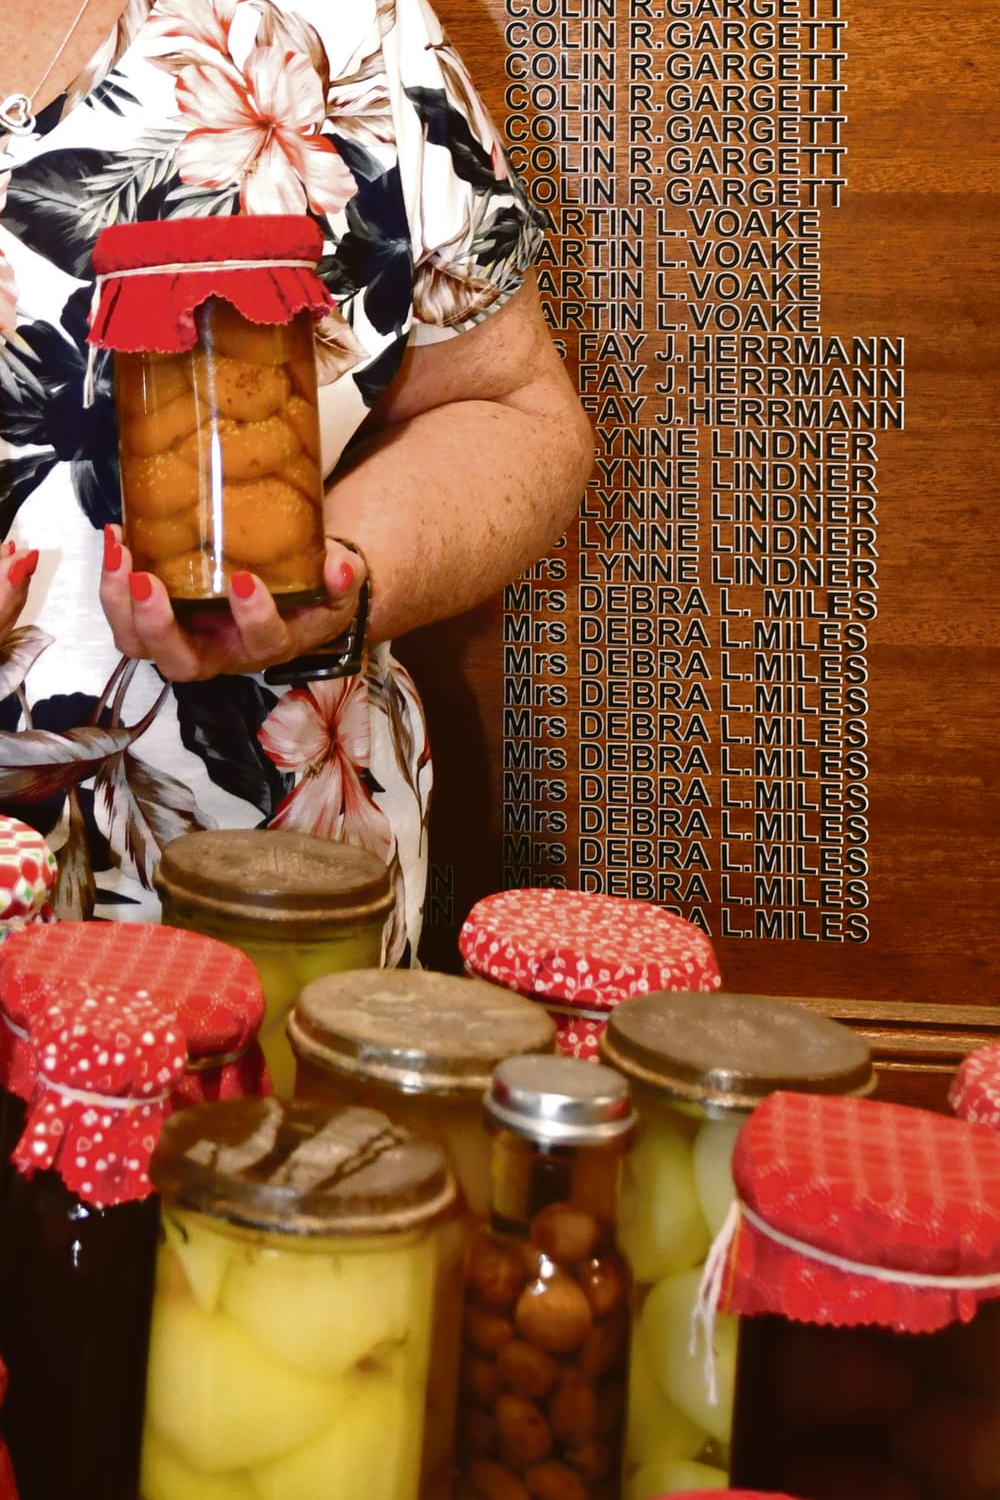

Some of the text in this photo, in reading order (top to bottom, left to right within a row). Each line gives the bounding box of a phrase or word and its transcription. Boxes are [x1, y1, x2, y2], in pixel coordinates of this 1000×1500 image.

[505, 51, 848, 81] COLIN R.GARGETT
[505, 113, 848, 144] COLIN R.GARGETT
[629, 146, 848, 175] R.GARGETT
[656, 209, 821, 239] L.VOAKE
[656, 241, 821, 270] L.VOAKE
[656, 272, 821, 302] L.VOAKE
[656, 303, 821, 334] L.VOAKE
[578, 333, 647, 362] FAY
[655, 335, 904, 367] J.HERRMANN
[578, 365, 904, 398] FAY J.HERRMANN
[655, 397, 904, 430] J.HERRMANN
[711, 429, 880, 461] LINDNER
[711, 460, 880, 494] LINDNER
[711, 492, 880, 526] LINDNER
[578, 521, 880, 557] LYNNE LINDNER
[578, 552, 880, 589] LYNNE LINDNER
[503, 583, 568, 613] Mrs
[579, 583, 711, 617] DEBRA
[763, 588, 879, 621] MILES
[503, 614, 868, 652] Mrs DEBRA L.MILES
[503, 645, 868, 684] Mrs DEBRA L.MILES
[503, 676, 868, 716] Mrs DEBRA L.MILES
[503, 708, 868, 749] Mrs DEBRA L.MILES
[503, 739, 868, 782] Mrs DEBRA L.MILES
[503, 771, 868, 814] Mrs DEBRA L.MILES
[578, 804, 711, 840] DEBRA
[720, 810, 868, 846] L.MILES
[578, 836, 868, 879] DEBRA L.MILES
[720, 874, 868, 910] L.MILES
[720, 907, 868, 944] L.MILES
